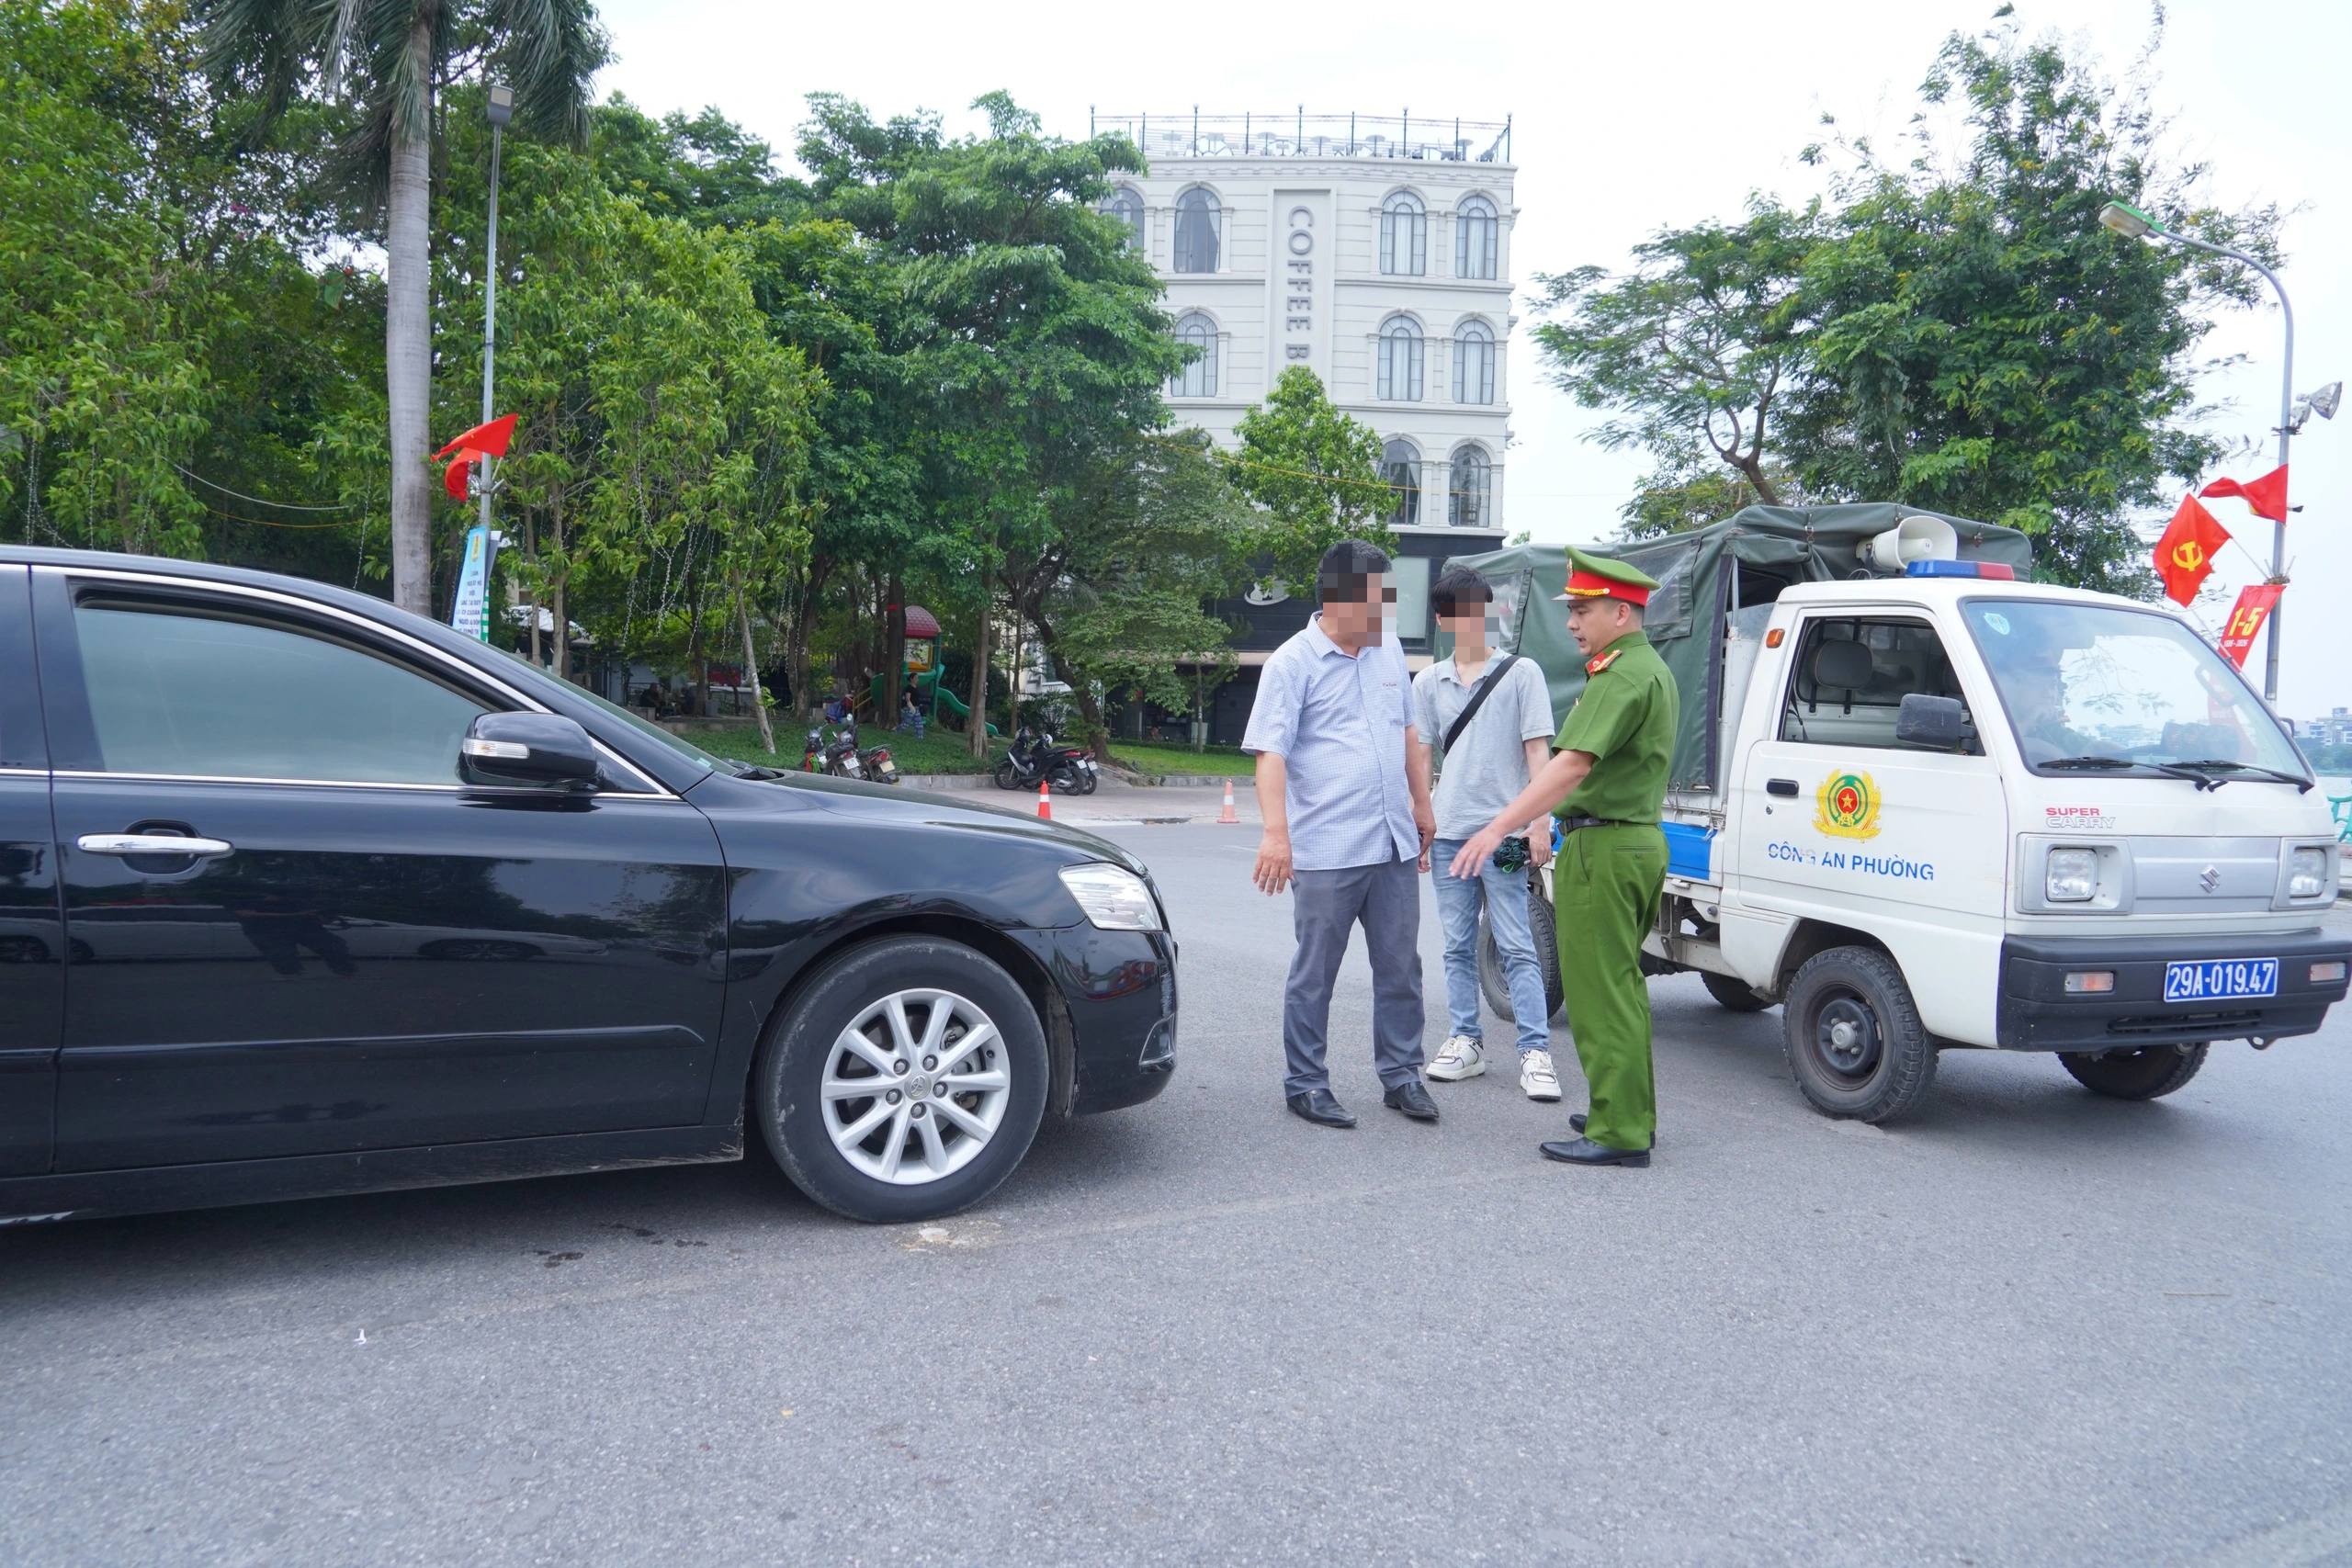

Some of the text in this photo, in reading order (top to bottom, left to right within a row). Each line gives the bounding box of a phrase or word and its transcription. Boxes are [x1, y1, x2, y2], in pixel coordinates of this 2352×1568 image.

[1286, 205, 1314, 332] COFFEE
[2228, 607, 2265, 637] 1-5
[2045, 807, 2100, 817] SUPER
[2045, 816, 2116, 829] CARRY
[1821, 851, 1846, 869] AN
[1851, 853, 1935, 881] PHƯỜNG
[2167, 962, 2275, 998] 29A-019.47
